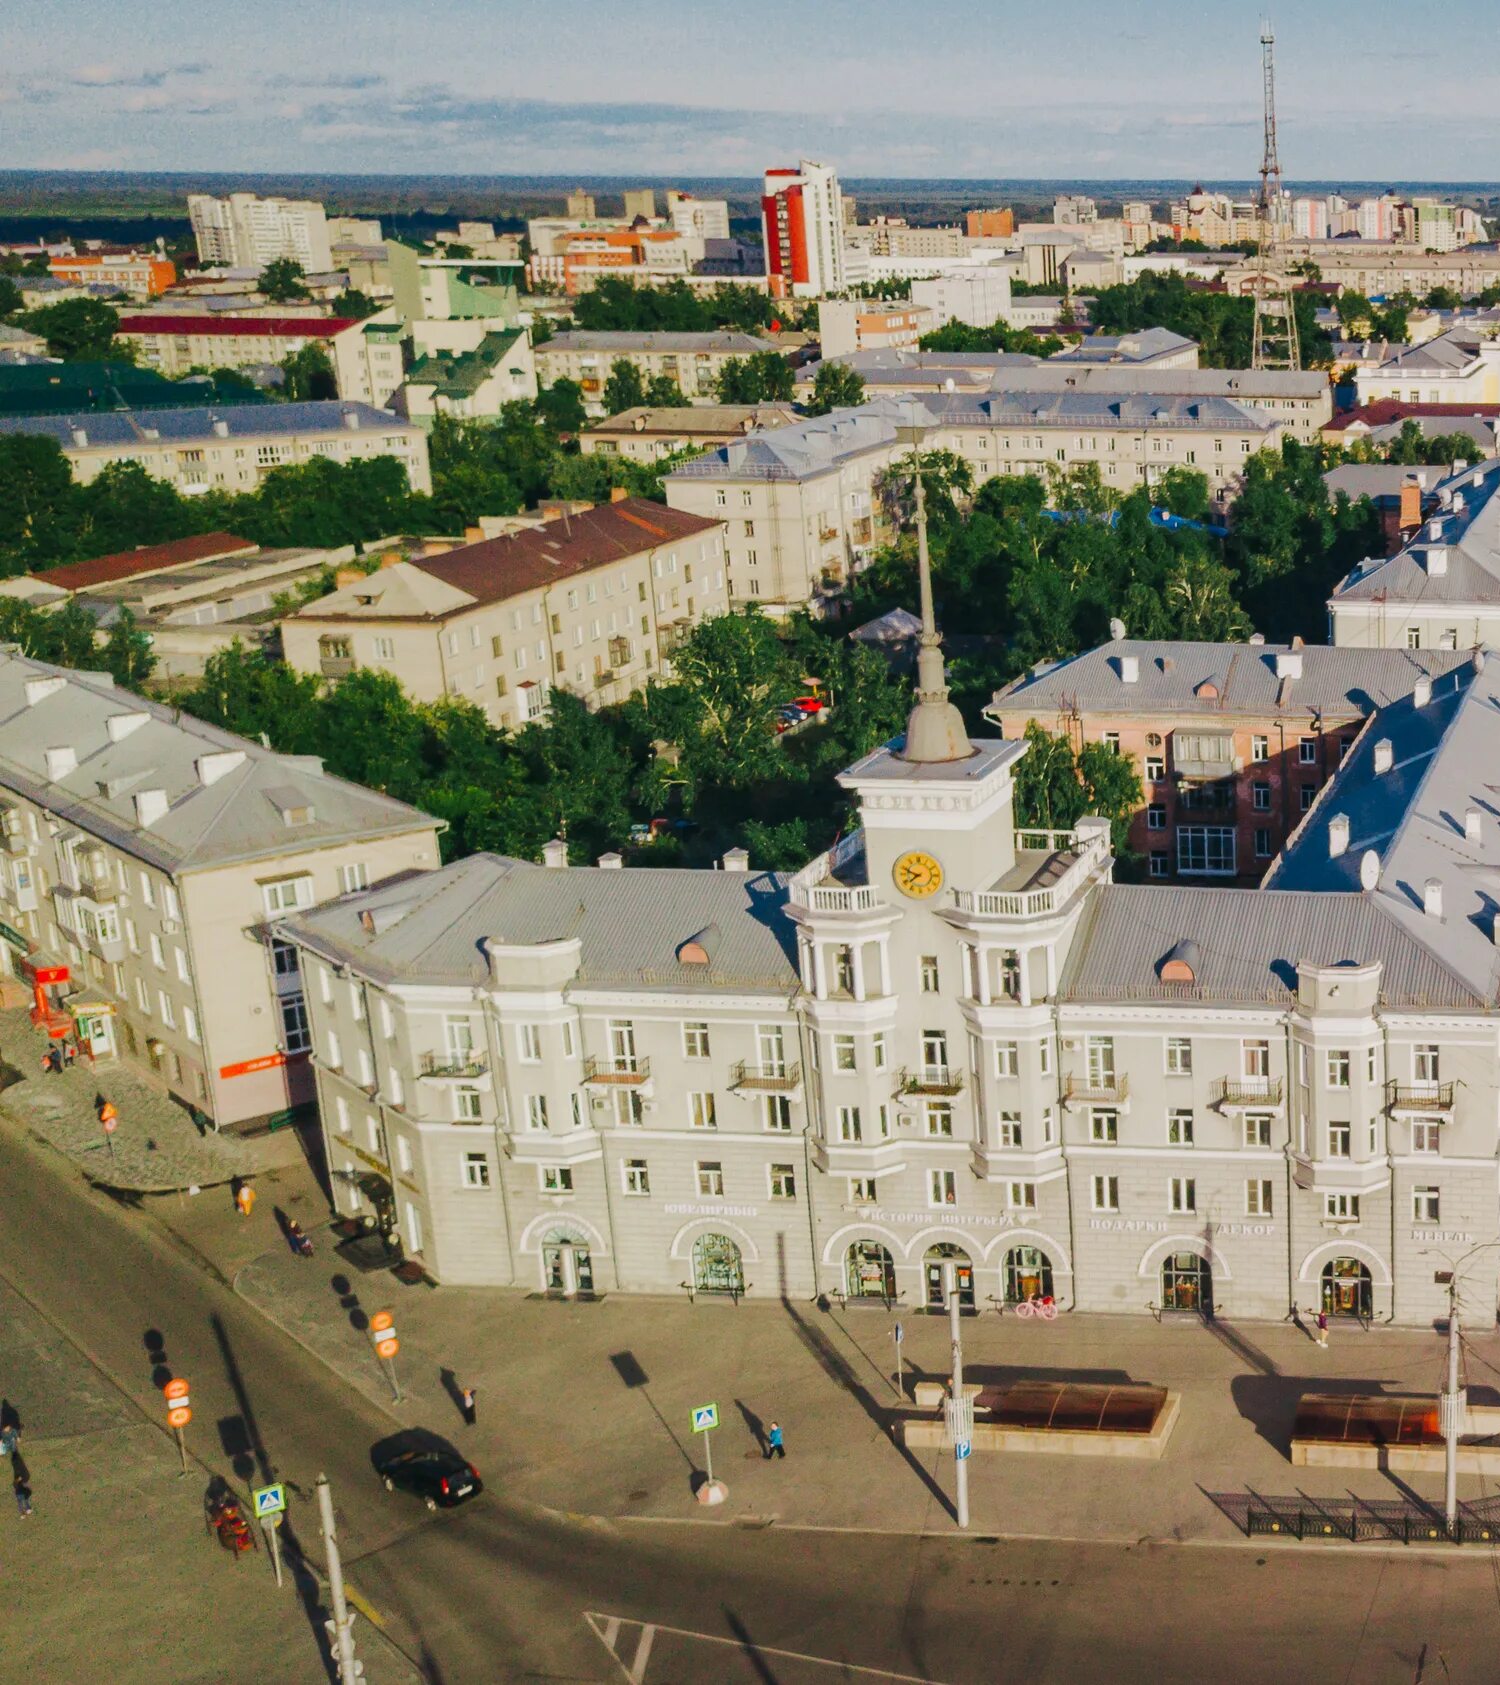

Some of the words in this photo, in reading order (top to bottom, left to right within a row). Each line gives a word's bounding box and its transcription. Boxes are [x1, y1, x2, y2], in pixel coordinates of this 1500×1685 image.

[1089, 1218, 1168, 1233] ПОДАРКИ
[1216, 1223, 1275, 1236] ДЕКОР
[1411, 1229, 1473, 1242] МЕБЕЛЬ
